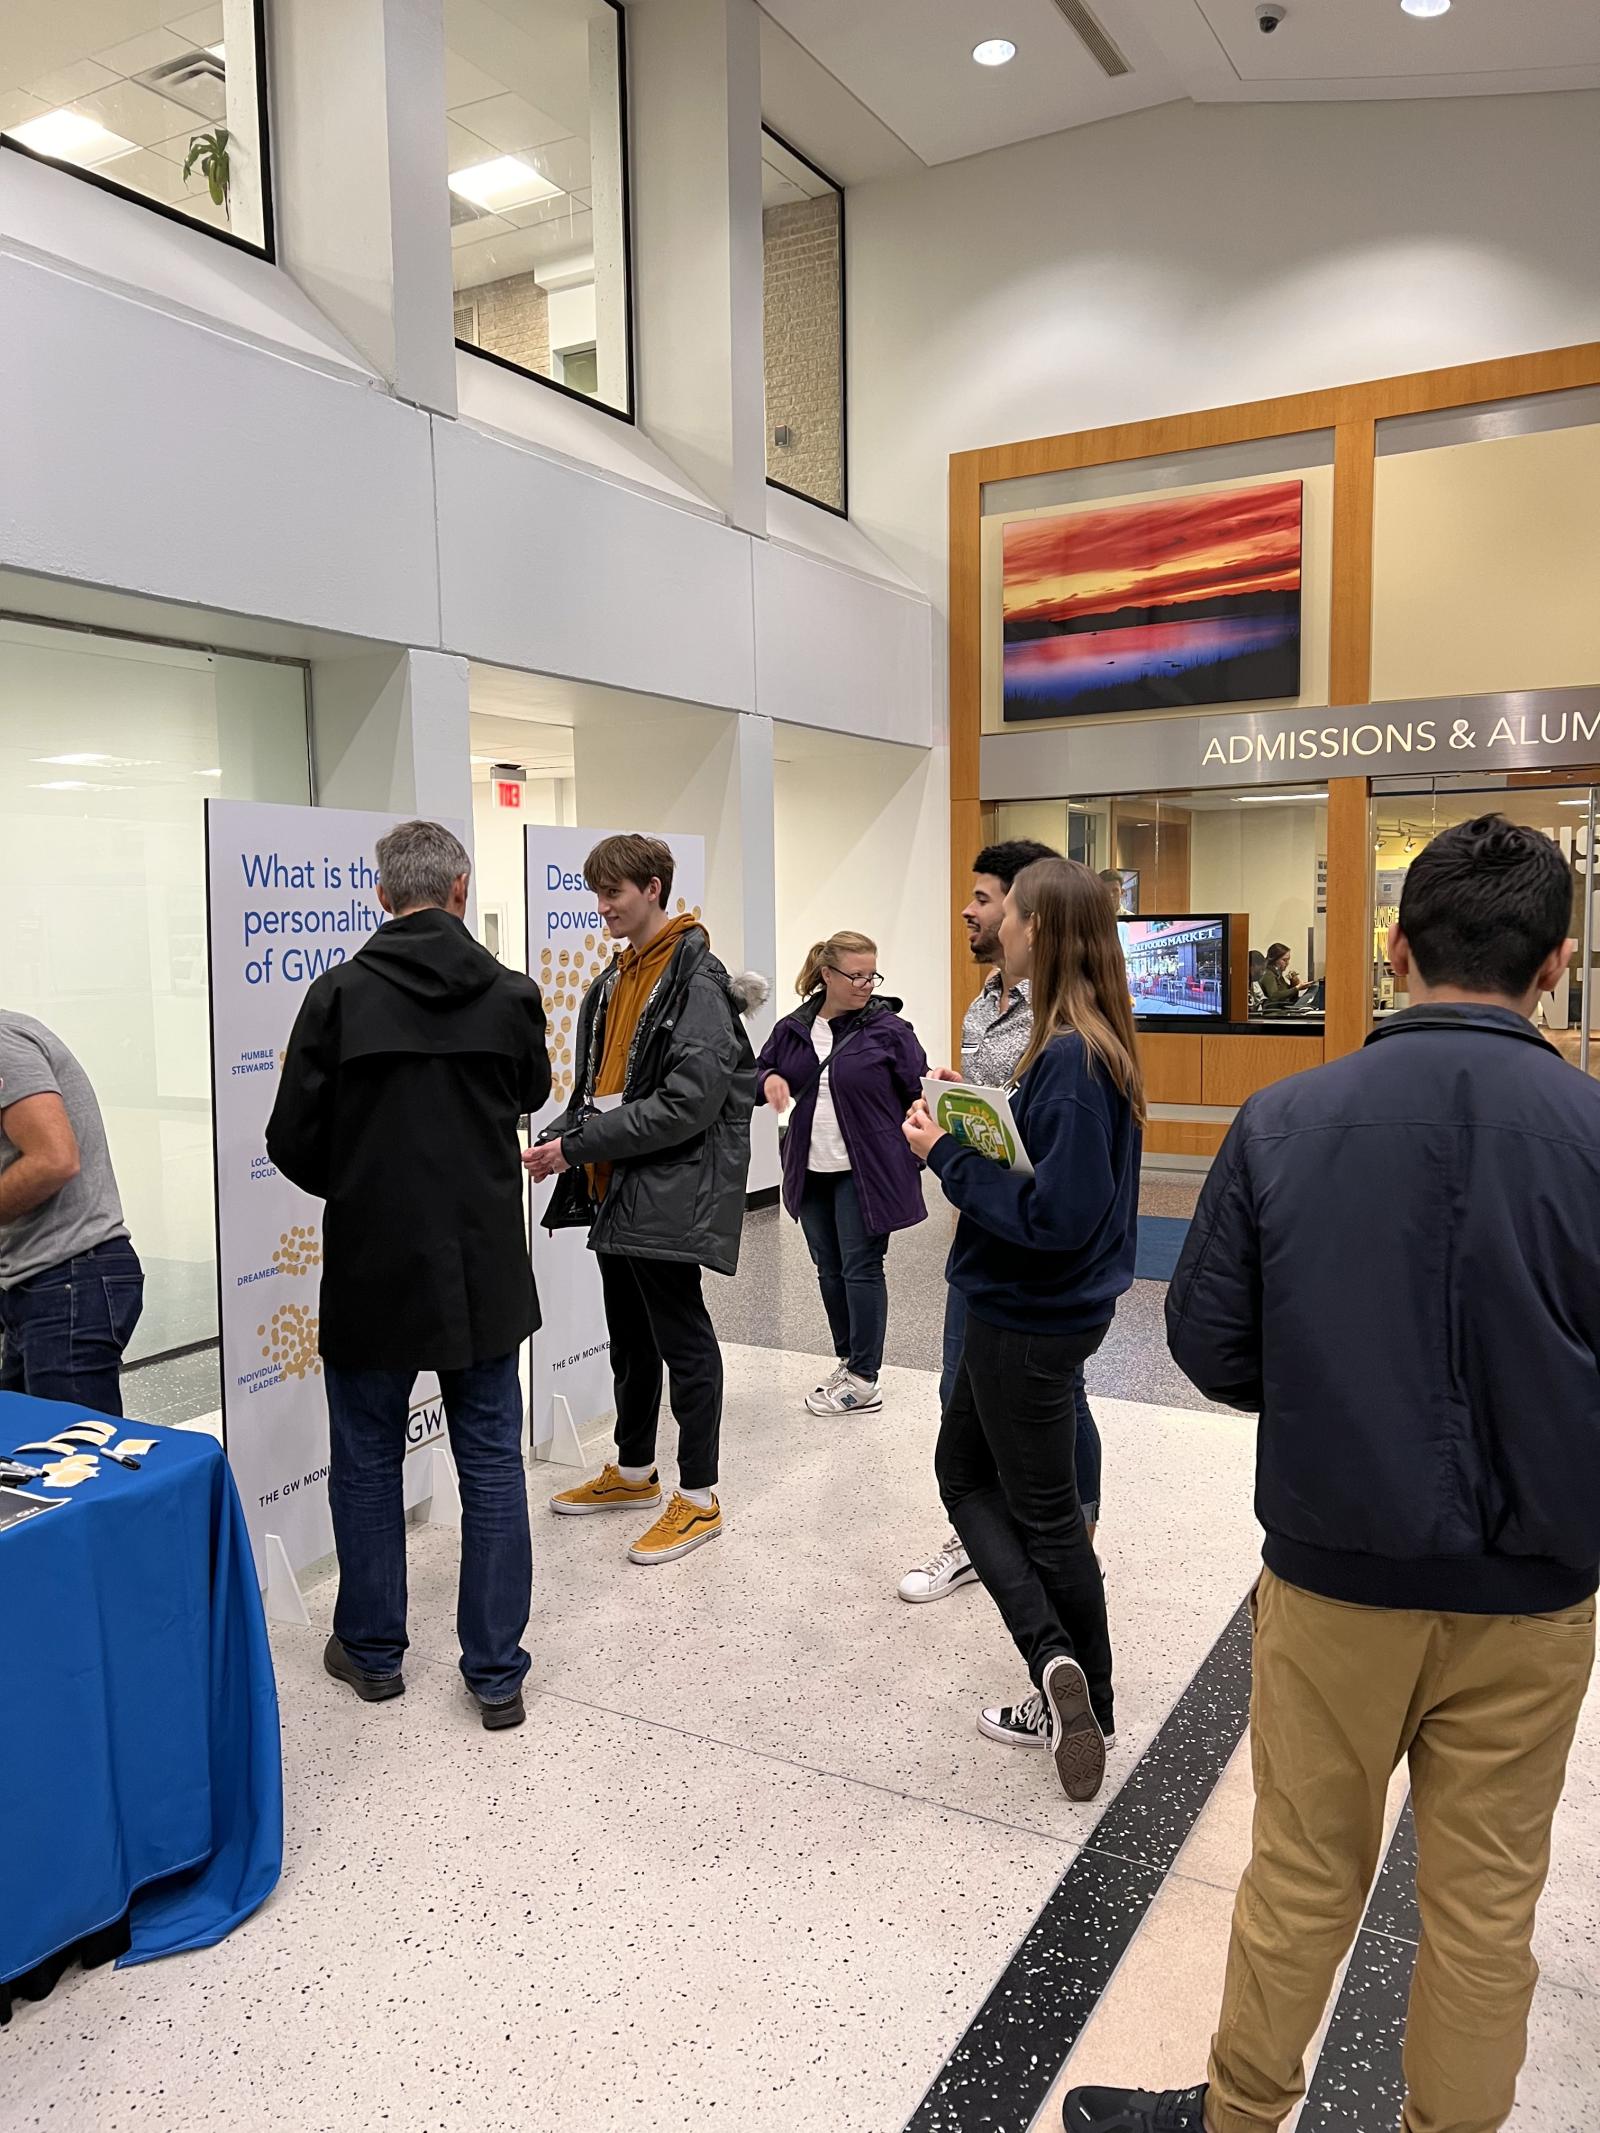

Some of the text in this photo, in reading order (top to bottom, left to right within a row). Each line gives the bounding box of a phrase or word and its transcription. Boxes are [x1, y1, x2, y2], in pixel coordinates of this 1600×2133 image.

[1202, 711, 1600, 766] ADMISSIONS & ALUM
[241, 853, 316, 889] What
[323, 857, 342, 889] is
[244, 900, 385, 947] personality
[1167, 928, 1215, 946] MARKET
[245, 948, 274, 985] of
[241, 1048, 274, 1062] HUMBLE
[231, 1061, 274, 1076] STEWARDS
[250, 1166, 277, 1181] FOCUS
[237, 1265, 281, 1287] DREAMERS
[237, 1362, 283, 1386] INDIVIDUAL
[552, 1360, 566, 1373] THE
[568, 1354, 581, 1366] GW
[407, 1402, 444, 1443] GW
[259, 1489, 280, 1508] THE
[282, 1479, 300, 1496] GW
